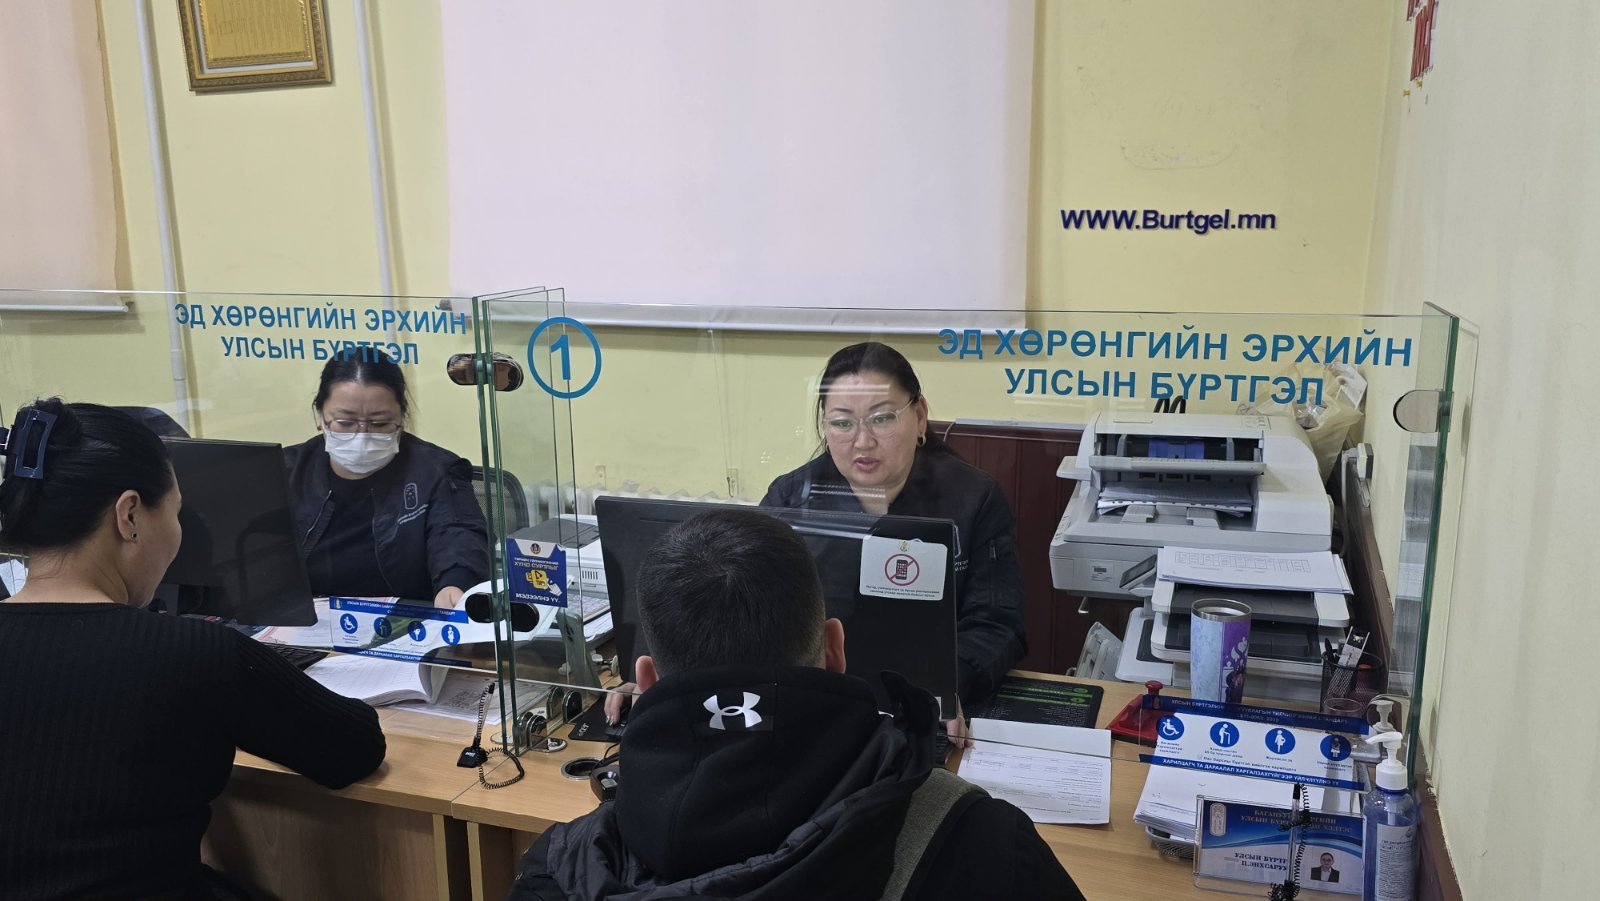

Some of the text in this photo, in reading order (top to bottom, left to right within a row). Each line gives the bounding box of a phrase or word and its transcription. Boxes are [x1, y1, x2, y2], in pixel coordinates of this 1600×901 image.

[174, 302, 467, 335] ЭД ХӨРӨНГИЙН ЭРХИЙН
[220, 335, 419, 366] УЛСЫН БҮРТГЭЛ
[550, 334, 571, 381] 1
[938, 325, 1412, 367] ЭД ХӨРӨНГИЙН ЭРХИЙН
[1005, 367, 1324, 406] УЛСЫН БҮРТГЭЛ
